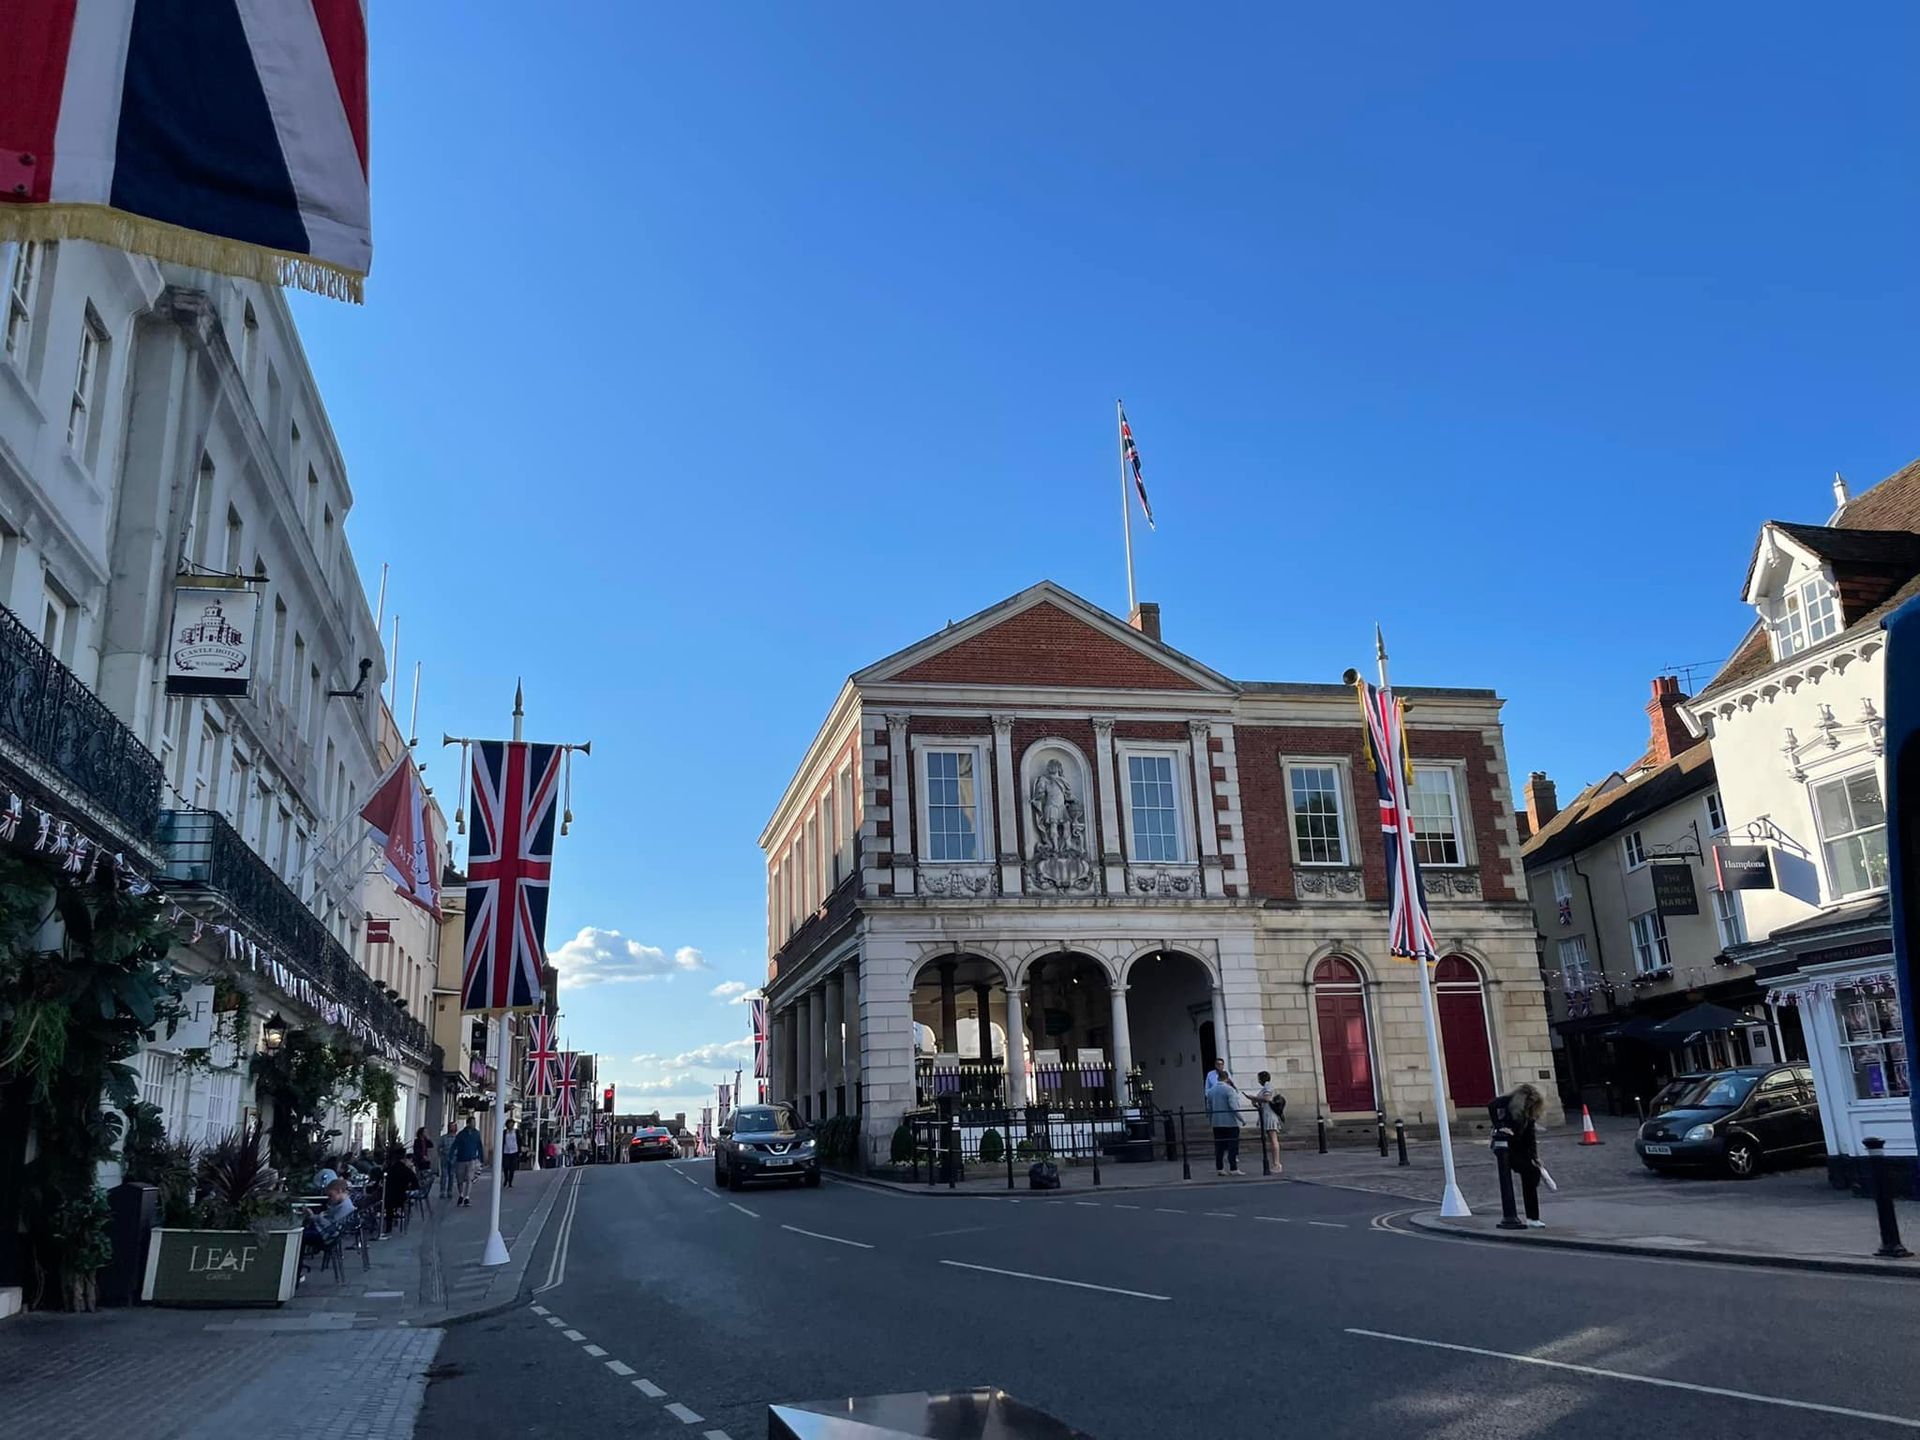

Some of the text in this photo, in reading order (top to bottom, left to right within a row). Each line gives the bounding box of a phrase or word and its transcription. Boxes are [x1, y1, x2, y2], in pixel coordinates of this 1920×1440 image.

[180, 648, 240, 659] CASTLE HOTEL
[1724, 860, 1766, 870] Hamptons
[1663, 874, 1681, 882] THE
[1657, 886, 1692, 894] PRINCE
[1660, 898, 1693, 907] HARRY
[188, 1245, 258, 1272] LEAF
